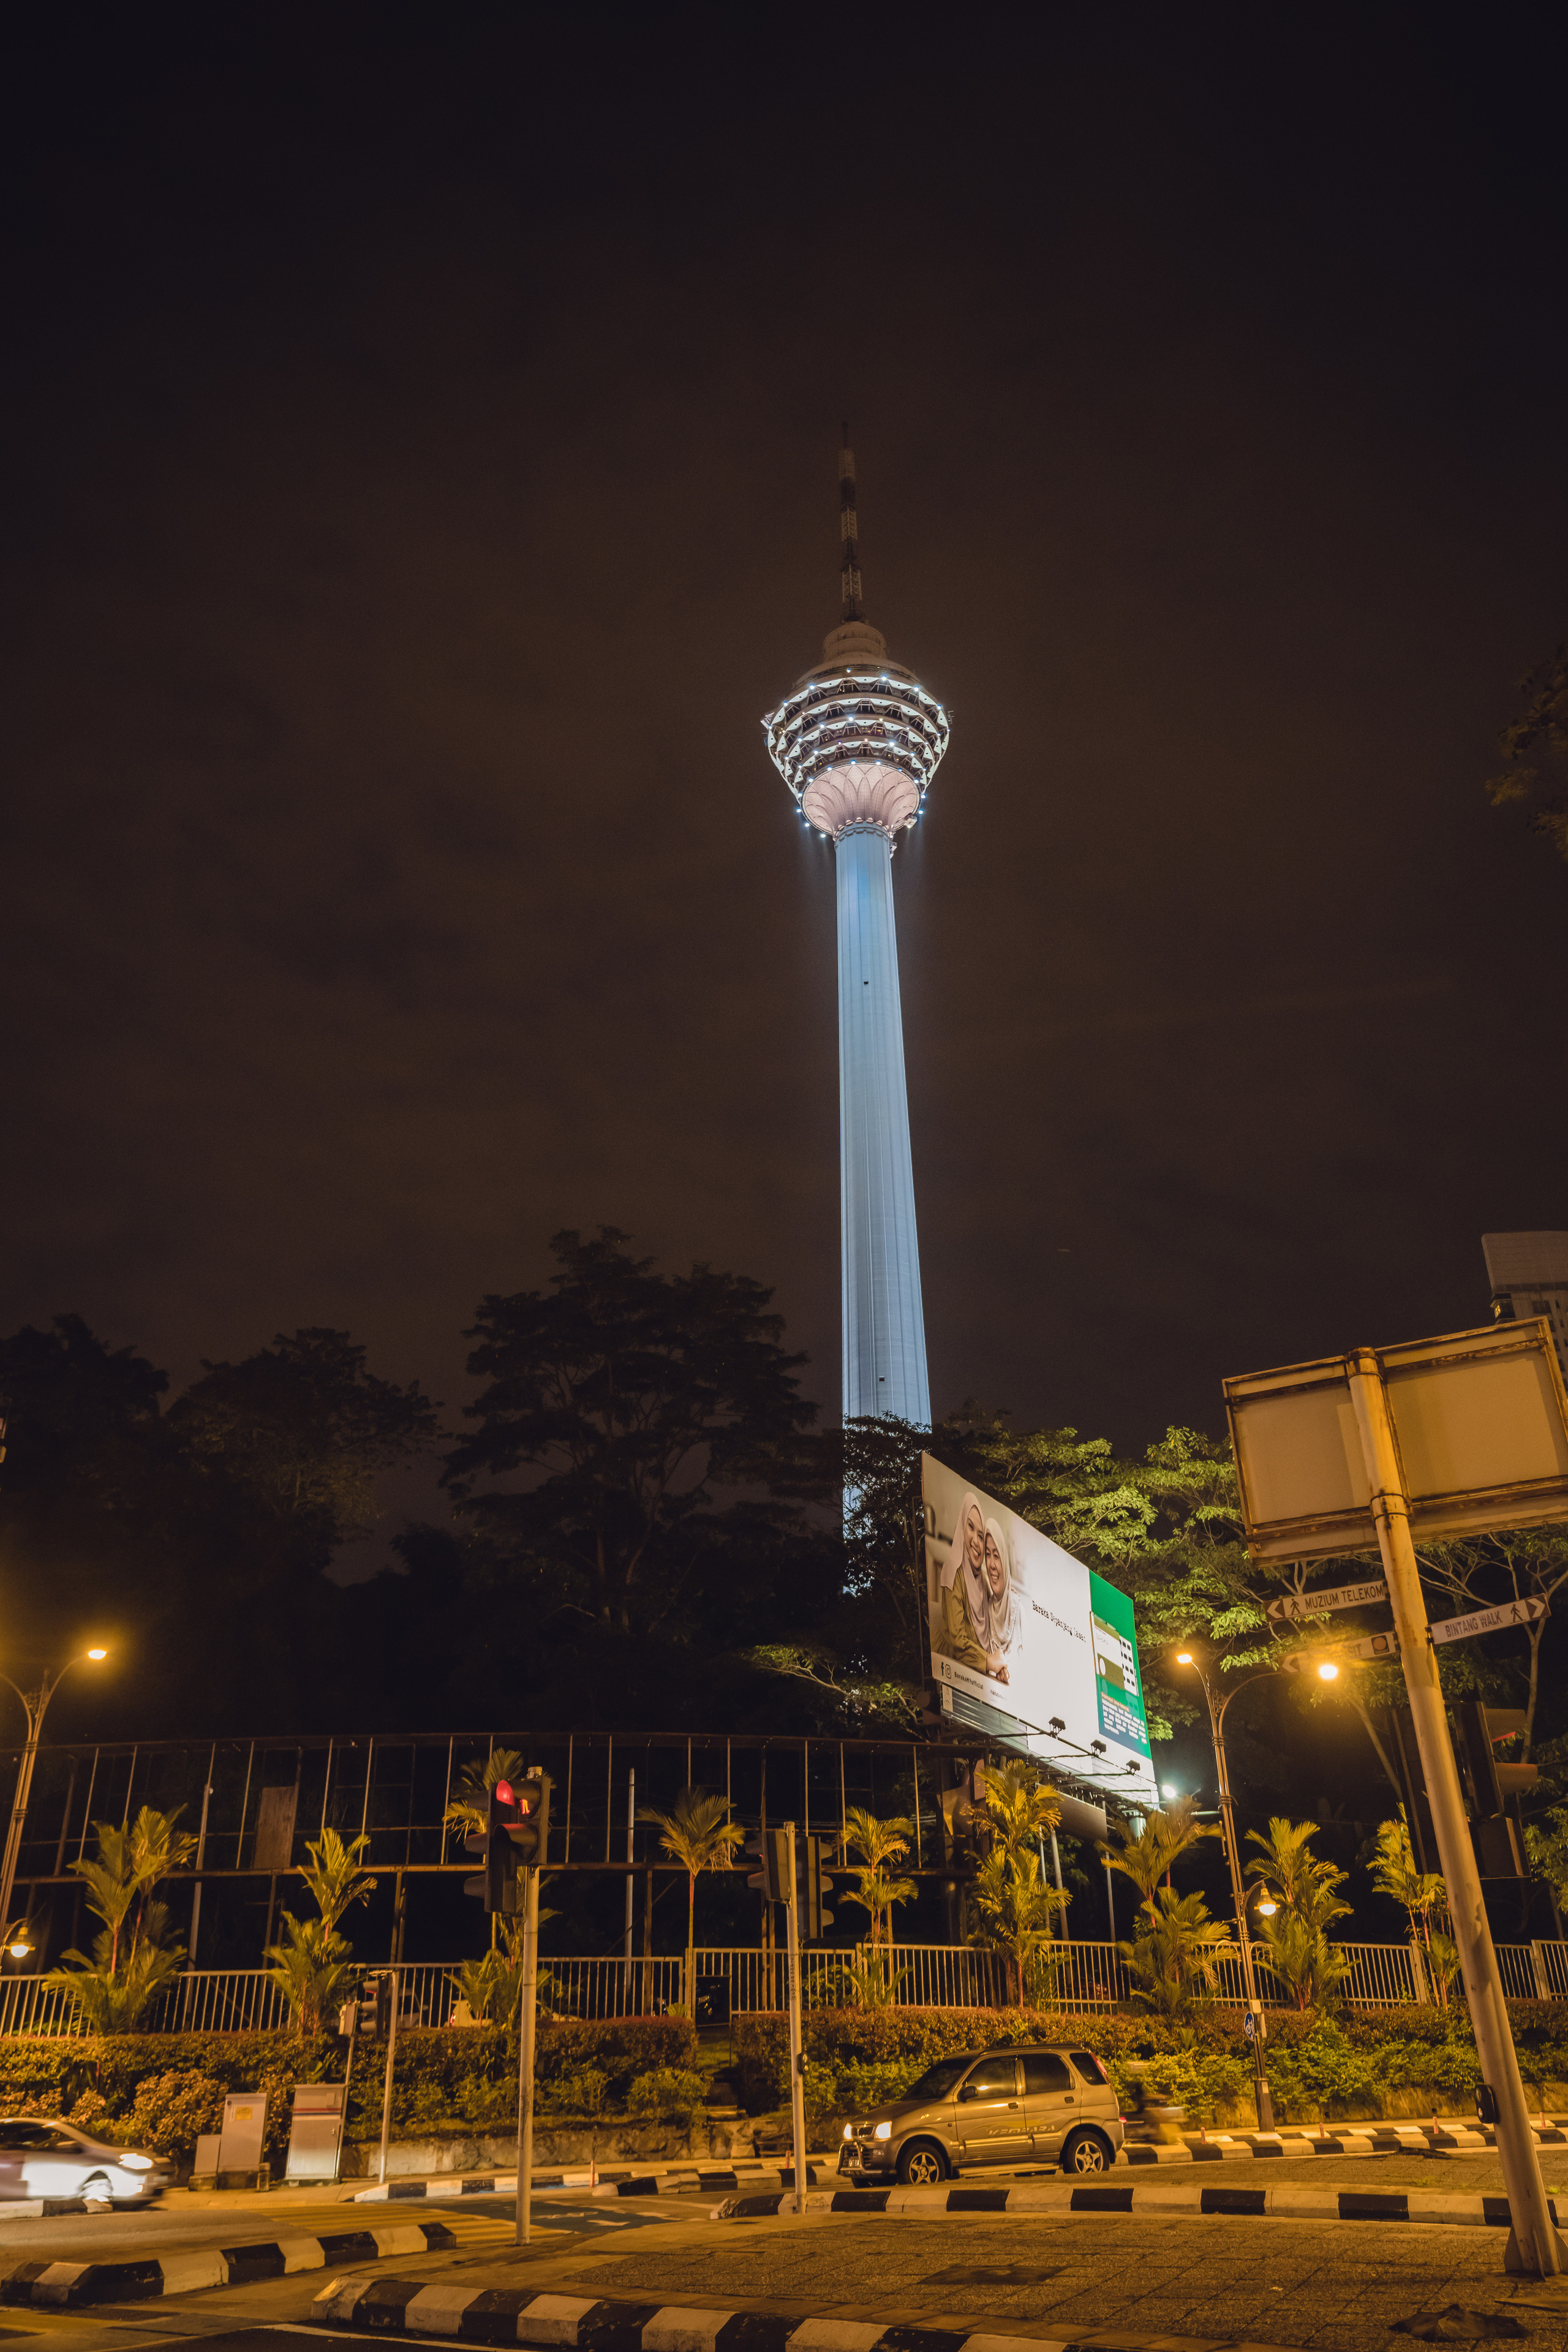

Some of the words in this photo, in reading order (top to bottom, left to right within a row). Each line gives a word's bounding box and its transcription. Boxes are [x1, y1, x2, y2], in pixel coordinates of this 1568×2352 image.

[1305, 1593, 1340, 1610] MUZIUM
[1341, 1584, 1385, 1603] TELEKOM
[1032, 1600, 1049, 1619] Baraka
[1050, 1611, 1072, 1636] Sepanjang
[1445, 1617, 1479, 1638] BINTANG
[1479, 1611, 1502, 1629] WALK
[954, 1671, 984, 1690] BarakaMYofficial
